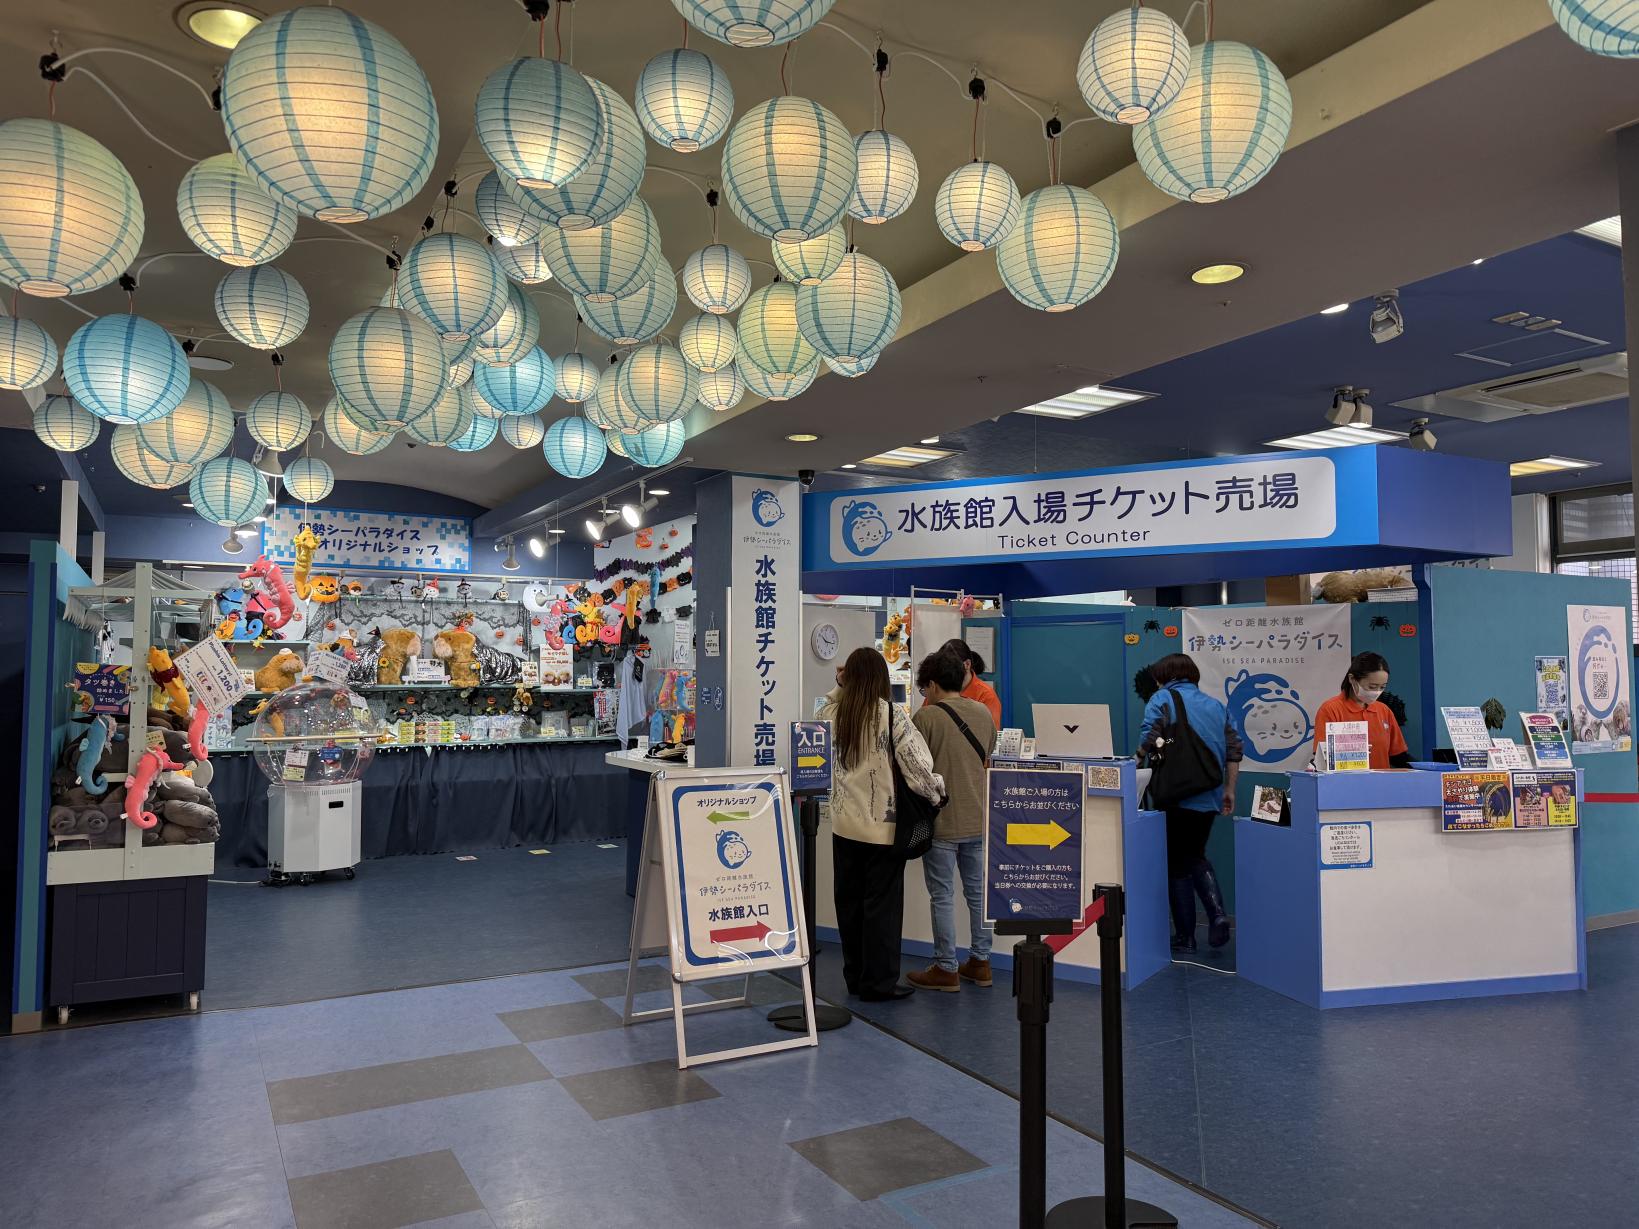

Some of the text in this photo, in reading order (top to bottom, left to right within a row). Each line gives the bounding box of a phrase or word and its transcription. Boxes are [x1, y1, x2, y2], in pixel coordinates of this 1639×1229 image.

[896, 472, 1300, 535] 水族館入場チケット売場
[298, 522, 421, 541] 伊勢シーパラダイス
[998, 527, 1151, 550] Ticket Counter
[318, 538, 439, 556] オリジナルショップ
[1222, 616, 1305, 628] ゼロ距離水族館
[1188, 630, 1343, 652] 伊勢シーパラダイス
[1240, 657, 1256, 665] SEA
[216, 669, 233, 692] 1,200
[797, 731, 826, 748] 入口
[1003, 787, 1069, 797] 水族館ご入場の方は
[696, 796, 757, 808] オリジナルショップ
[993, 800, 1080, 810] こちらからお並びください
[699, 881, 772, 897] 伊勢シーパラダイス
[708, 904, 770, 922] 水族館入口
